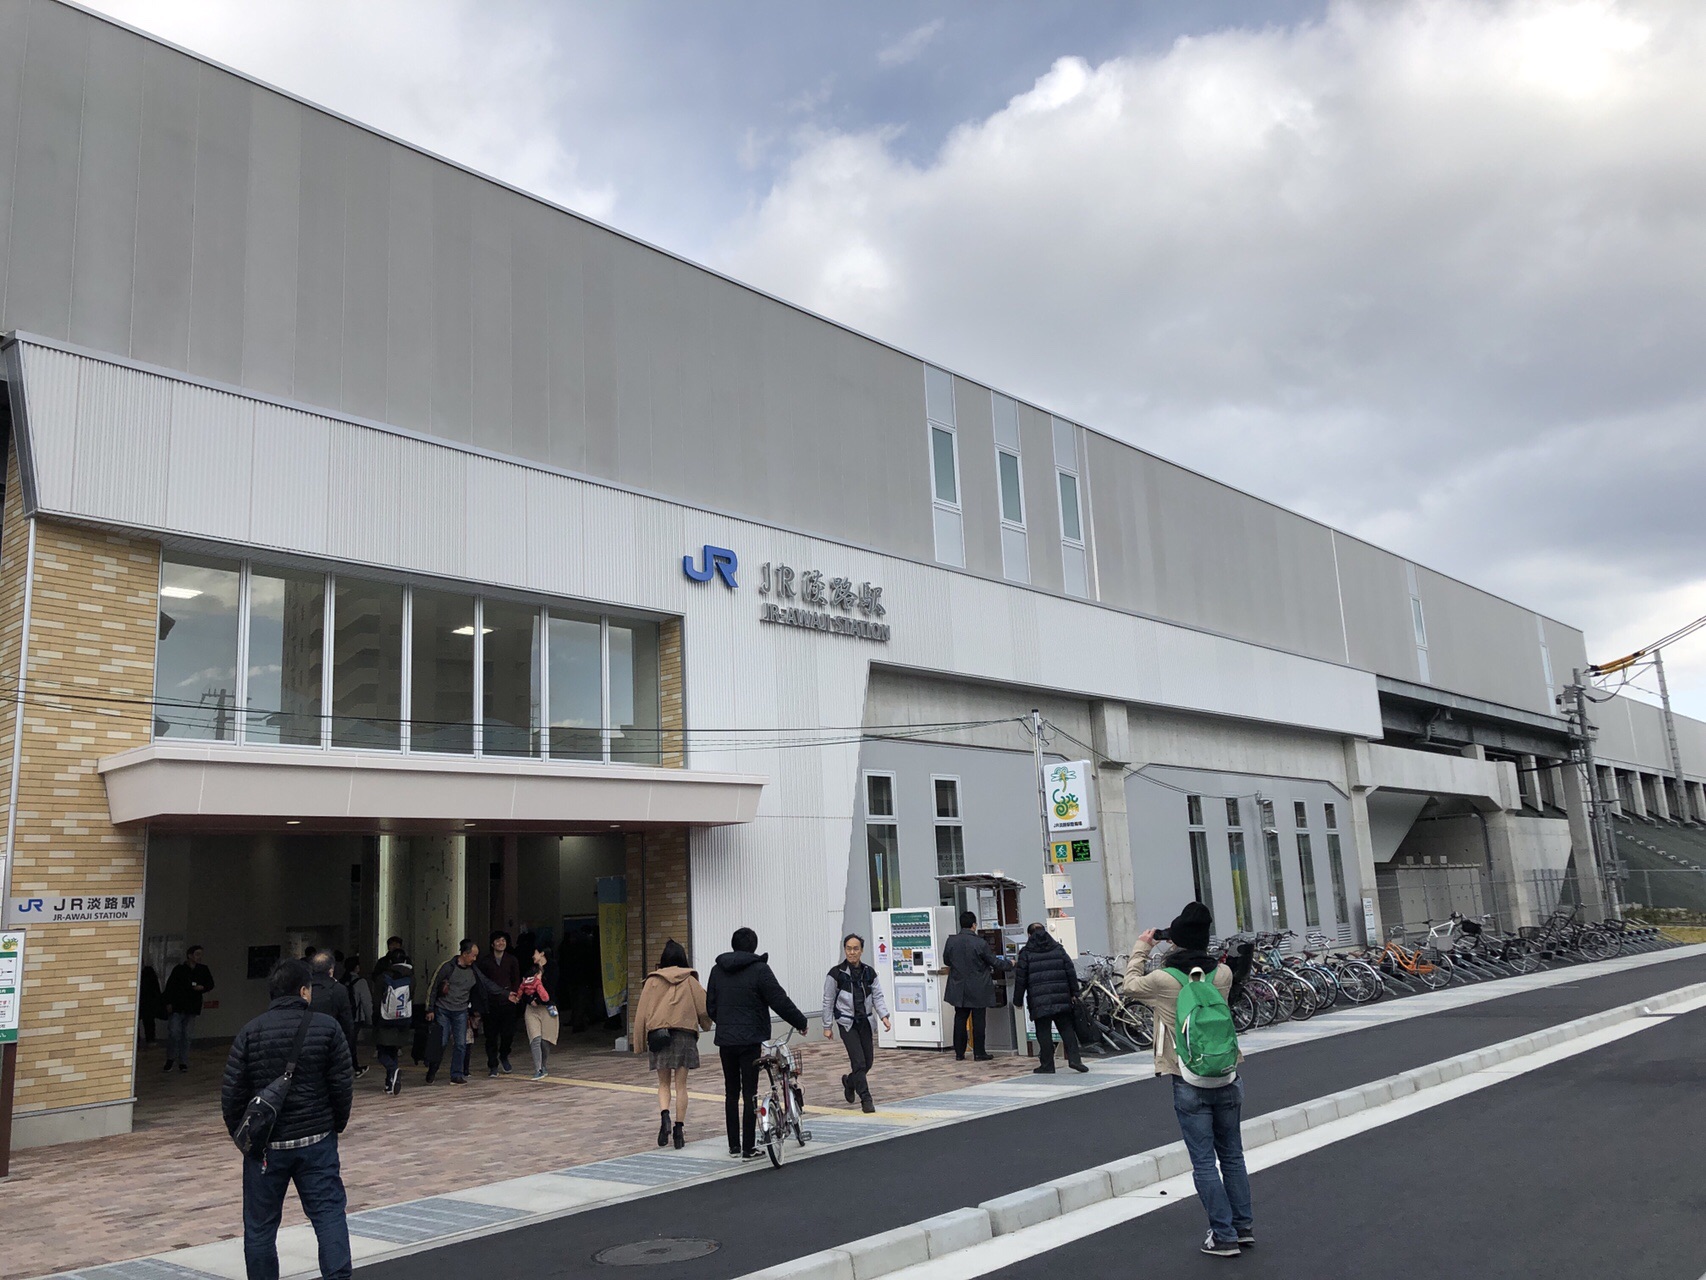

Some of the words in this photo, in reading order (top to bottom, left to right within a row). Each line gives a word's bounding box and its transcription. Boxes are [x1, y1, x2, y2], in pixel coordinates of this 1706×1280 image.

[683, 545, 739, 588] JR
[759, 562, 886, 616] JR淡路駅
[761, 603, 831, 631] JR-AWAJI
[832, 616, 890, 641] STATION
[18, 899, 43, 912] JR
[53, 913, 92, 921] JR-AWAJI
[94, 911, 128, 919] STATION
[54, 897, 135, 911] JR淡路駅
[396, 993, 405, 1018] FILA
